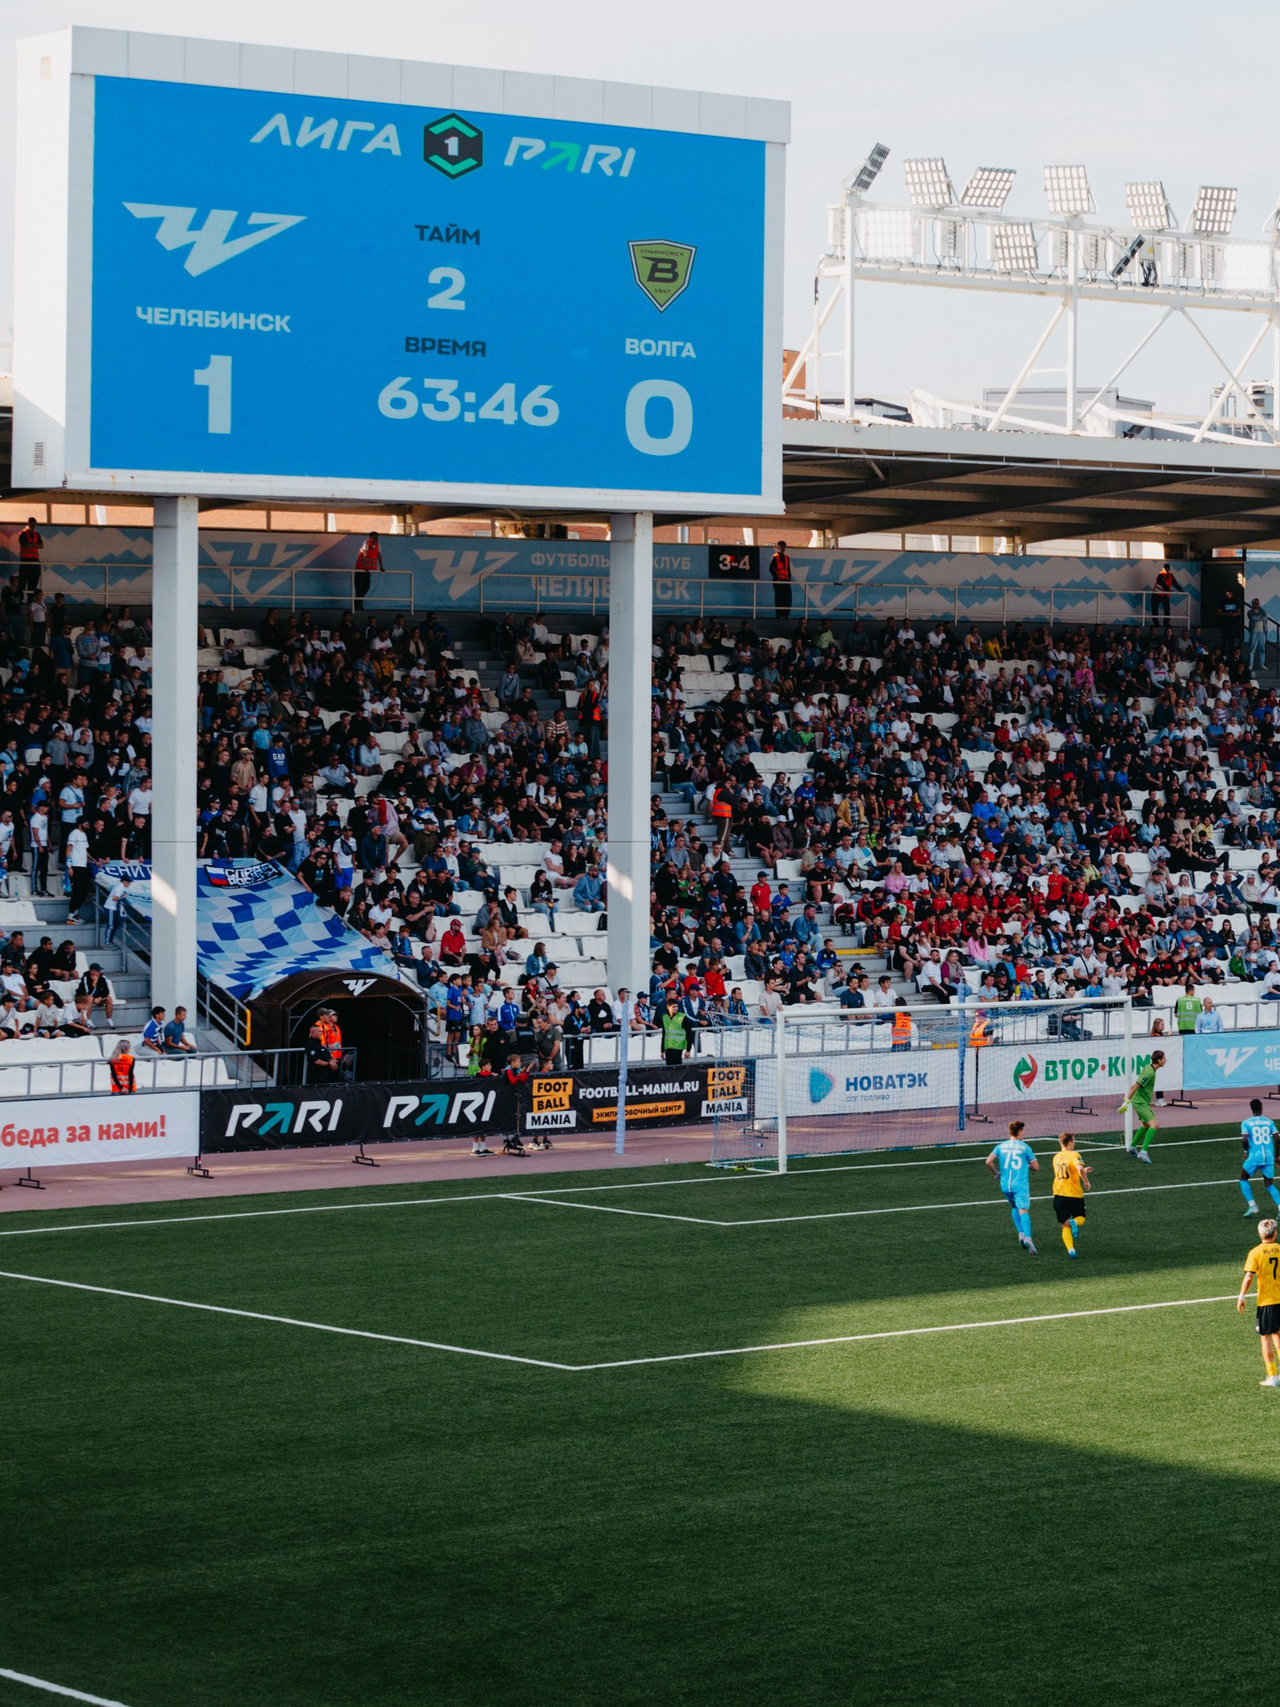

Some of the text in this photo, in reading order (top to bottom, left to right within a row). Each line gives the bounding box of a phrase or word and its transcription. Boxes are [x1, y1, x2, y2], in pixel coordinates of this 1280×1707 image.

[250, 113, 636, 178] ЛИГА 1 PARI
[414, 223, 480, 245] ТАЙМ
[427, 266, 465, 310] 2
[136, 306, 292, 333] ЧЕЛЯБИНСК
[405, 336, 487, 357] ВРЕМЯ
[625, 337, 697, 358] ВОЛГА
[193, 354, 232, 434] 1
[378, 376, 560, 426] 63:46
[625, 379, 693, 456] 0
[530, 552, 610, 569] ФУТБОЛЬ
[718, 554, 750, 572] 3-4
[531, 577, 690, 600] ЧЕЛЯСК
[1186, 1001, 1193, 1010] 8
[712, 1070, 741, 1082] FOOT
[845, 1072, 928, 1092] НОВАТЭК
[537, 1082, 569, 1093] FOOT
[579, 1080, 700, 1100] FOOTBLL-MANIA.RU
[712, 1085, 738, 1099] BALL
[383, 1090, 497, 1128] PARI
[537, 1098, 565, 1111] BALL
[595, 1104, 682, 1119] ЭКИПОВОЧНЫЙ ЦЕНТР
[706, 1103, 743, 1115] MANIA
[225, 1099, 343, 1137] PARI
[530, 1114, 571, 1127] MANIA
[66, 1124, 91, 1143] за
[98, 1115, 166, 1141] нами!
[1252, 1126, 1270, 1145] 88
[1002, 1149, 1022, 1170] 75
[1269, 1256, 1279, 1280] 7
